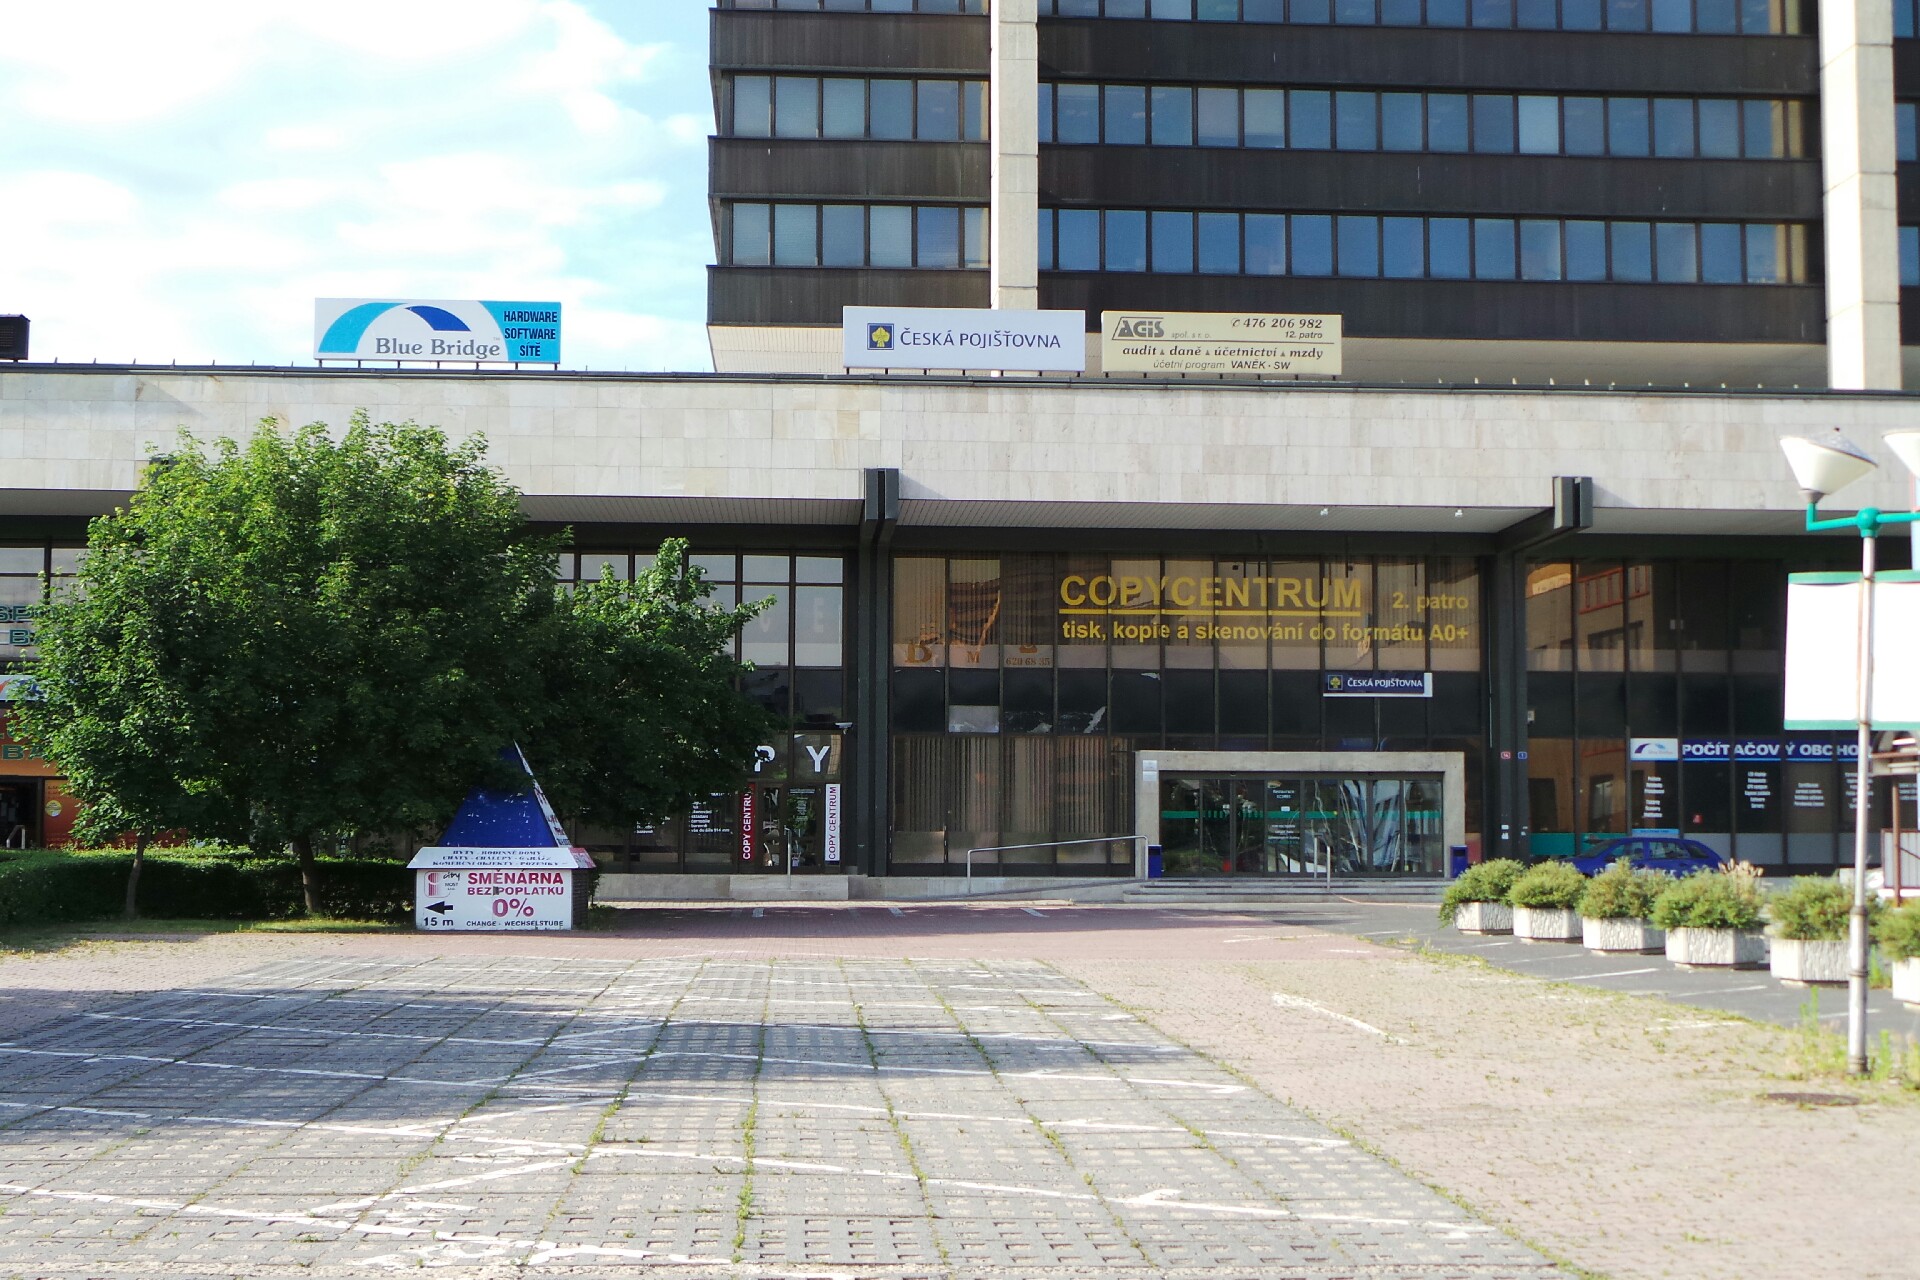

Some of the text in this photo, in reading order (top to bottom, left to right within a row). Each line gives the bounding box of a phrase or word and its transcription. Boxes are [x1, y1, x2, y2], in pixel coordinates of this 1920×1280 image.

[504, 311, 558, 322] HARDWARE
[1243, 319, 1323, 329] 476 206 982
[504, 328, 556, 340] SOFTWARE
[900, 327, 1061, 348] ČESKÁ POJIŠŤOVNA
[1299, 332, 1323, 340] patro
[376, 338, 500, 360] Blue Bridge
[519, 342, 541, 357] SÍTĚ
[1122, 346, 1323, 360] audit daně účetnictví mzdy
[1153, 360, 1184, 368] účetní
[1185, 362, 1225, 370] program
[1273, 362, 1290, 370] SW
[1060, 575, 1362, 608] COPYCENTRUM
[1392, 592, 1470, 612] 2. patro
[1062, 620, 1469, 643] tisk, kopie a skenování do formátu A0+
[1347, 678, 1423, 688] ČESKÁ POJIŠŤOVNA
[1800, 744, 1871, 756] OBCHO
[742, 788, 752, 860] COPY CENTRU
[828, 786, 836, 860] COPY CENTRUM
[468, 869, 564, 884] SMĚNÁRNA
[468, 887, 564, 896] BEZ POPLATKU
[492, 898, 534, 917] 0%
[424, 917, 438, 926] 15
